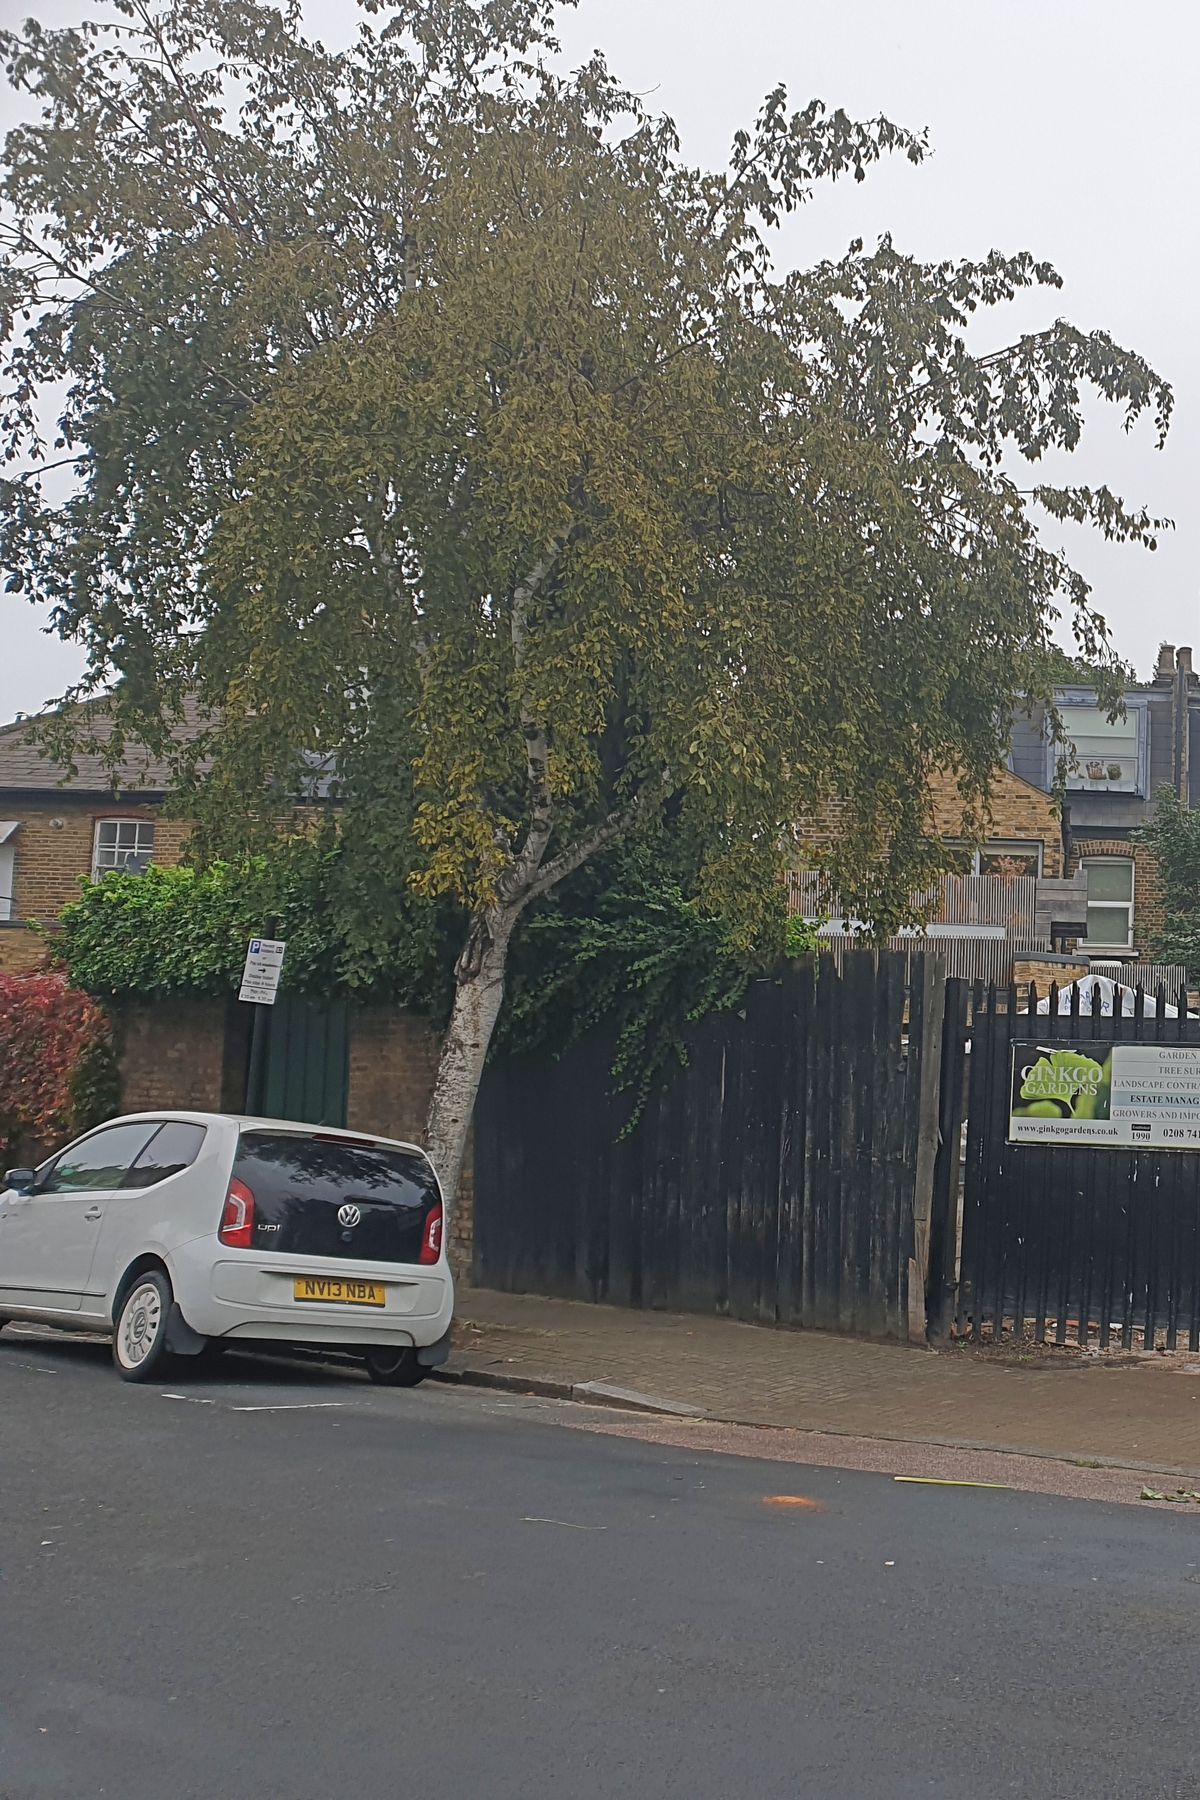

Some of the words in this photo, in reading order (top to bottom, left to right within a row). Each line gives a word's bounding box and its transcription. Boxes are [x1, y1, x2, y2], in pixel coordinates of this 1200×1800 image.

[251, 941, 260, 953] P
[1159, 1051, 1197, 1060] GARDEN
[1021, 1065, 1103, 1083] GINKGO
[1159, 1066, 1182, 1075] TREE
[1025, 1082, 1098, 1096] GARDENS
[1113, 1080, 1165, 1089] LANDSCAPE
[1130, 1094, 1163, 1104] ESTATE
[1112, 1109, 1157, 1119] GROWERS
[1158, 1111, 1178, 1119] AND
[1017, 1124, 1119, 1136] www.ginkgogardens.co.uk
[1163, 1128, 1185, 1138] 0208
[1131, 1132, 1151, 1140] 1990
[257, 1224, 281, 1232] up!
[305, 1280, 342, 1297] NV13
[346, 1283, 376, 1300] NBA
